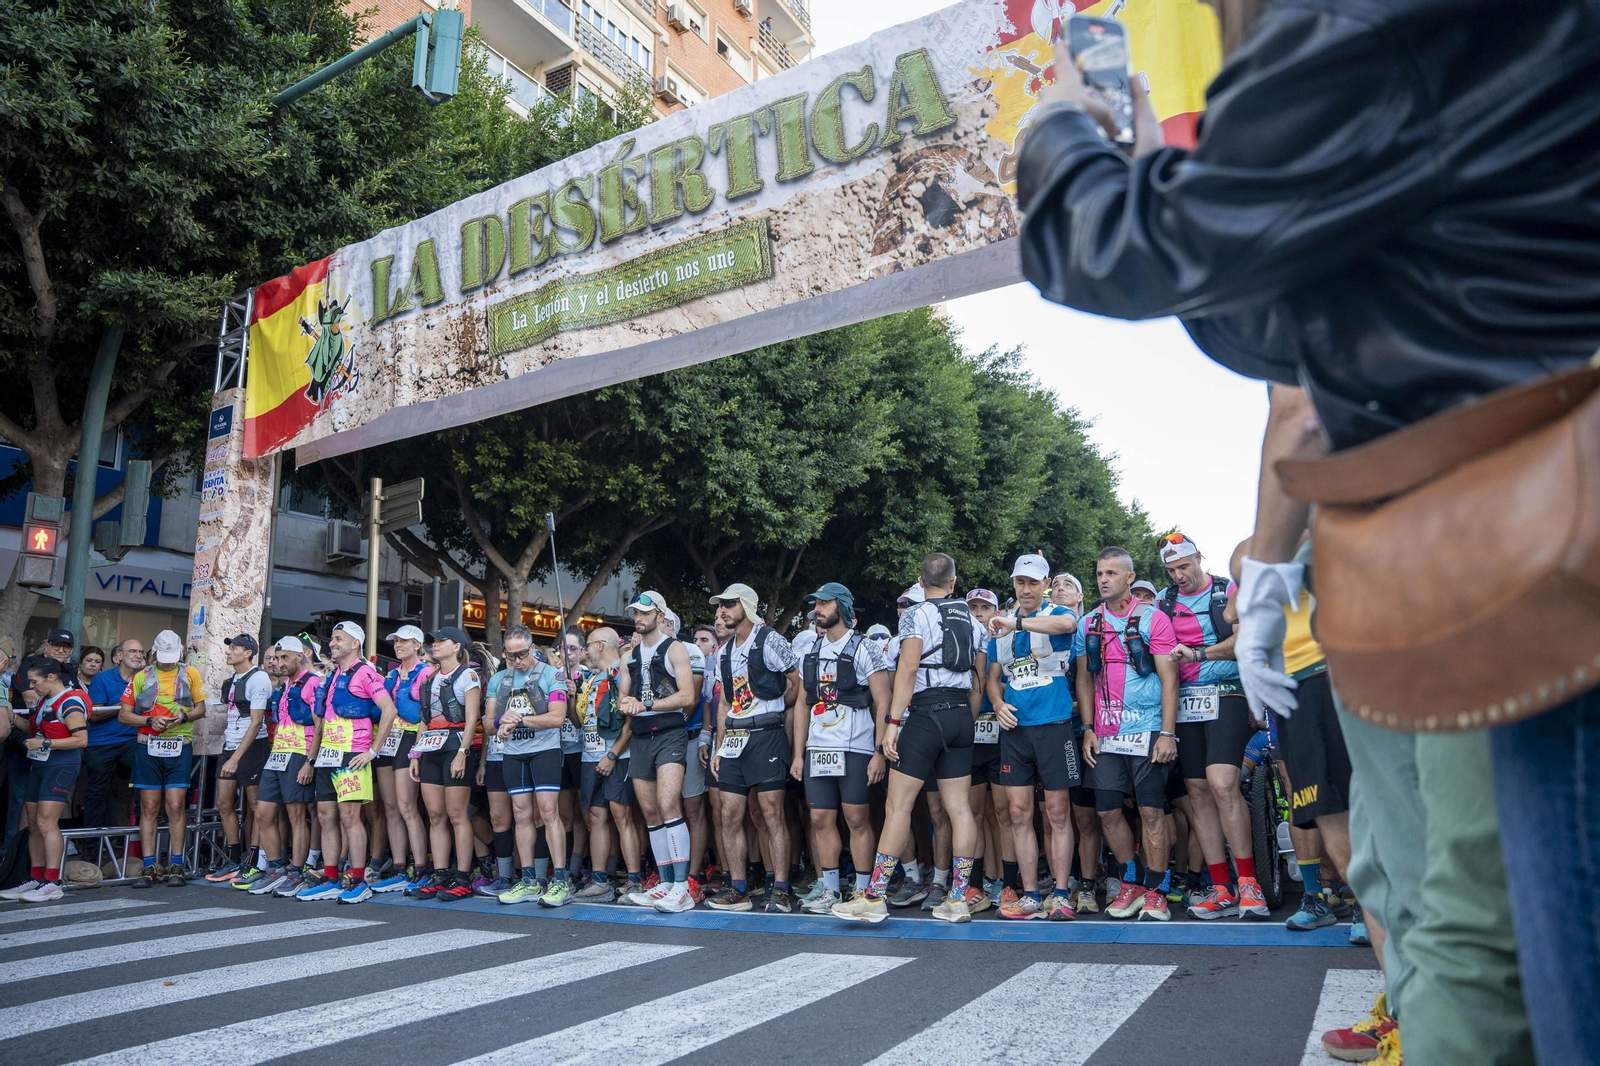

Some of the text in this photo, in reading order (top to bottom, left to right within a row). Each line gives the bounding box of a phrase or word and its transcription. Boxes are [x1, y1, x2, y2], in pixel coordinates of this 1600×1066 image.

[369, 46, 959, 328] LA DESÉRTICA
[511, 250, 736, 331] La Legión y el desierto nos une
[203, 476, 224, 490] RENTA
[1182, 696, 1212, 710] 1776
[561, 723, 573, 733] 85
[974, 721, 993, 733] 150
[424, 736, 443, 746] 1413
[511, 730, 535, 741] 3000
[156, 741, 178, 750] 1480
[382, 738, 397, 747] 135
[726, 737, 744, 748] 4601
[272, 752, 287, 763] 4138
[321, 748, 340, 758] 4136
[816, 752, 839, 765] 4600
[1292, 784, 1319, 810] ARMY
